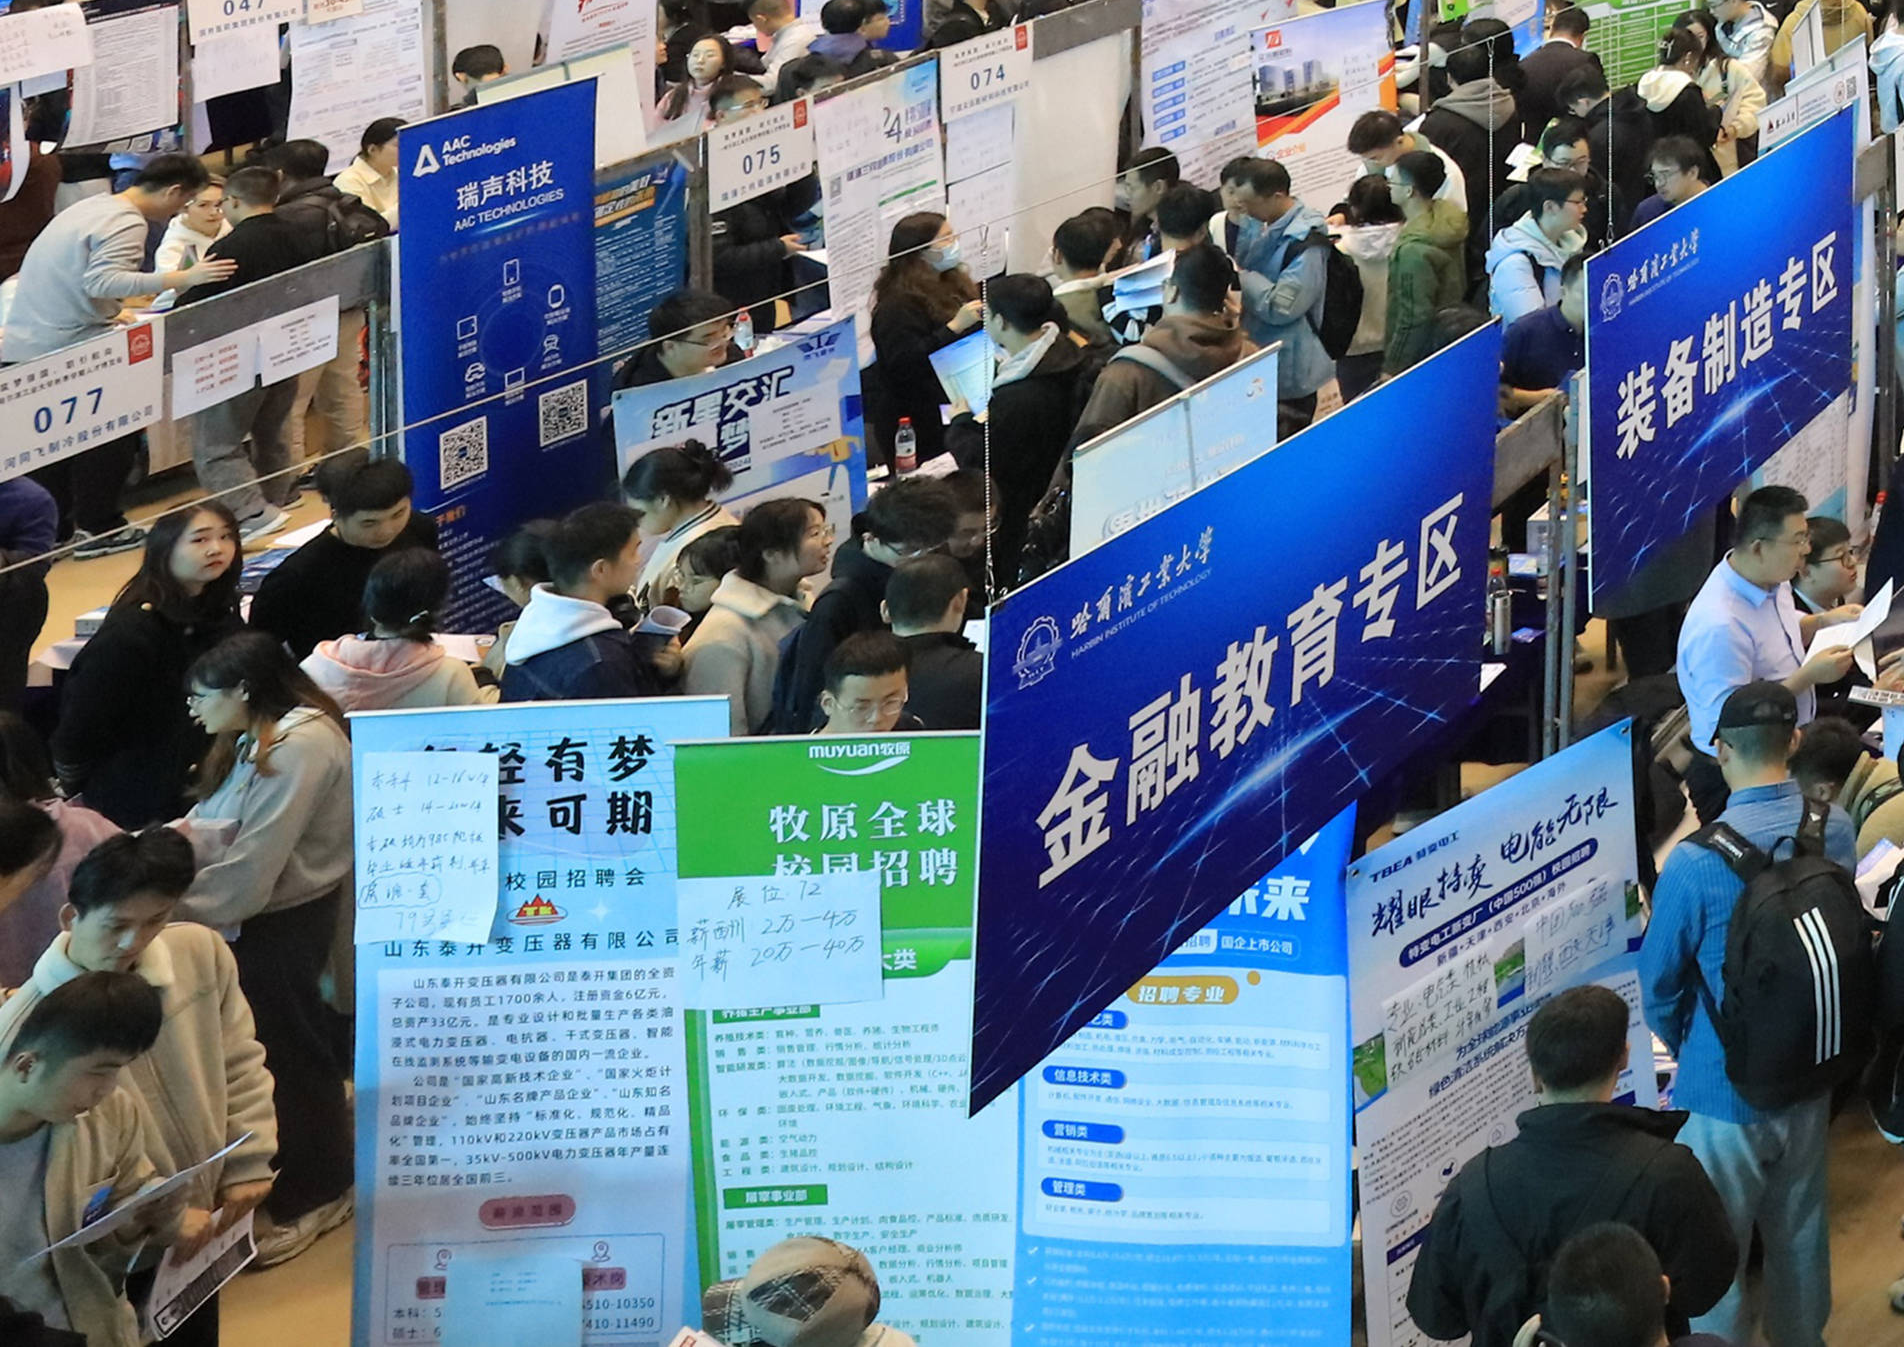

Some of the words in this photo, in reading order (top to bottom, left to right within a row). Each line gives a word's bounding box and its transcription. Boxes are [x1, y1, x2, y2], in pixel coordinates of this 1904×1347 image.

[970, 64, 1006, 91] 074
[442, 134, 472, 154] AAC
[442, 137, 517, 168] Technologies
[742, 144, 781, 175] 075
[456, 160, 555, 212] 瑞声科技
[454, 214, 476, 232] AAC
[478, 188, 565, 226] TECHNOLOGIES
[1615, 231, 1839, 460] 装备制造专区
[33, 387, 103, 434] 077
[0, 404, 154, 472] 河同飞制冷股份有限公司
[1104, 610, 1147, 641] INSTITUTE
[1160, 567, 1214, 606] TECHNOLOGY
[1035, 492, 1465, 890] 金融教育专区
[809, 741, 912, 759] muyuan牧原
[769, 799, 958, 845] 牧原全球
[505, 866, 648, 892] 校园招聘会
[1369, 852, 1413, 884] TBEA
[1221, 935, 1294, 956] 国企上市公司
[1138, 984, 1226, 1004] 招聘专业
[1054, 1068, 1113, 1087] 信息技术类
[1054, 1123, 1089, 1139] 营销类
[1051, 1180, 1087, 1199] 管理类
